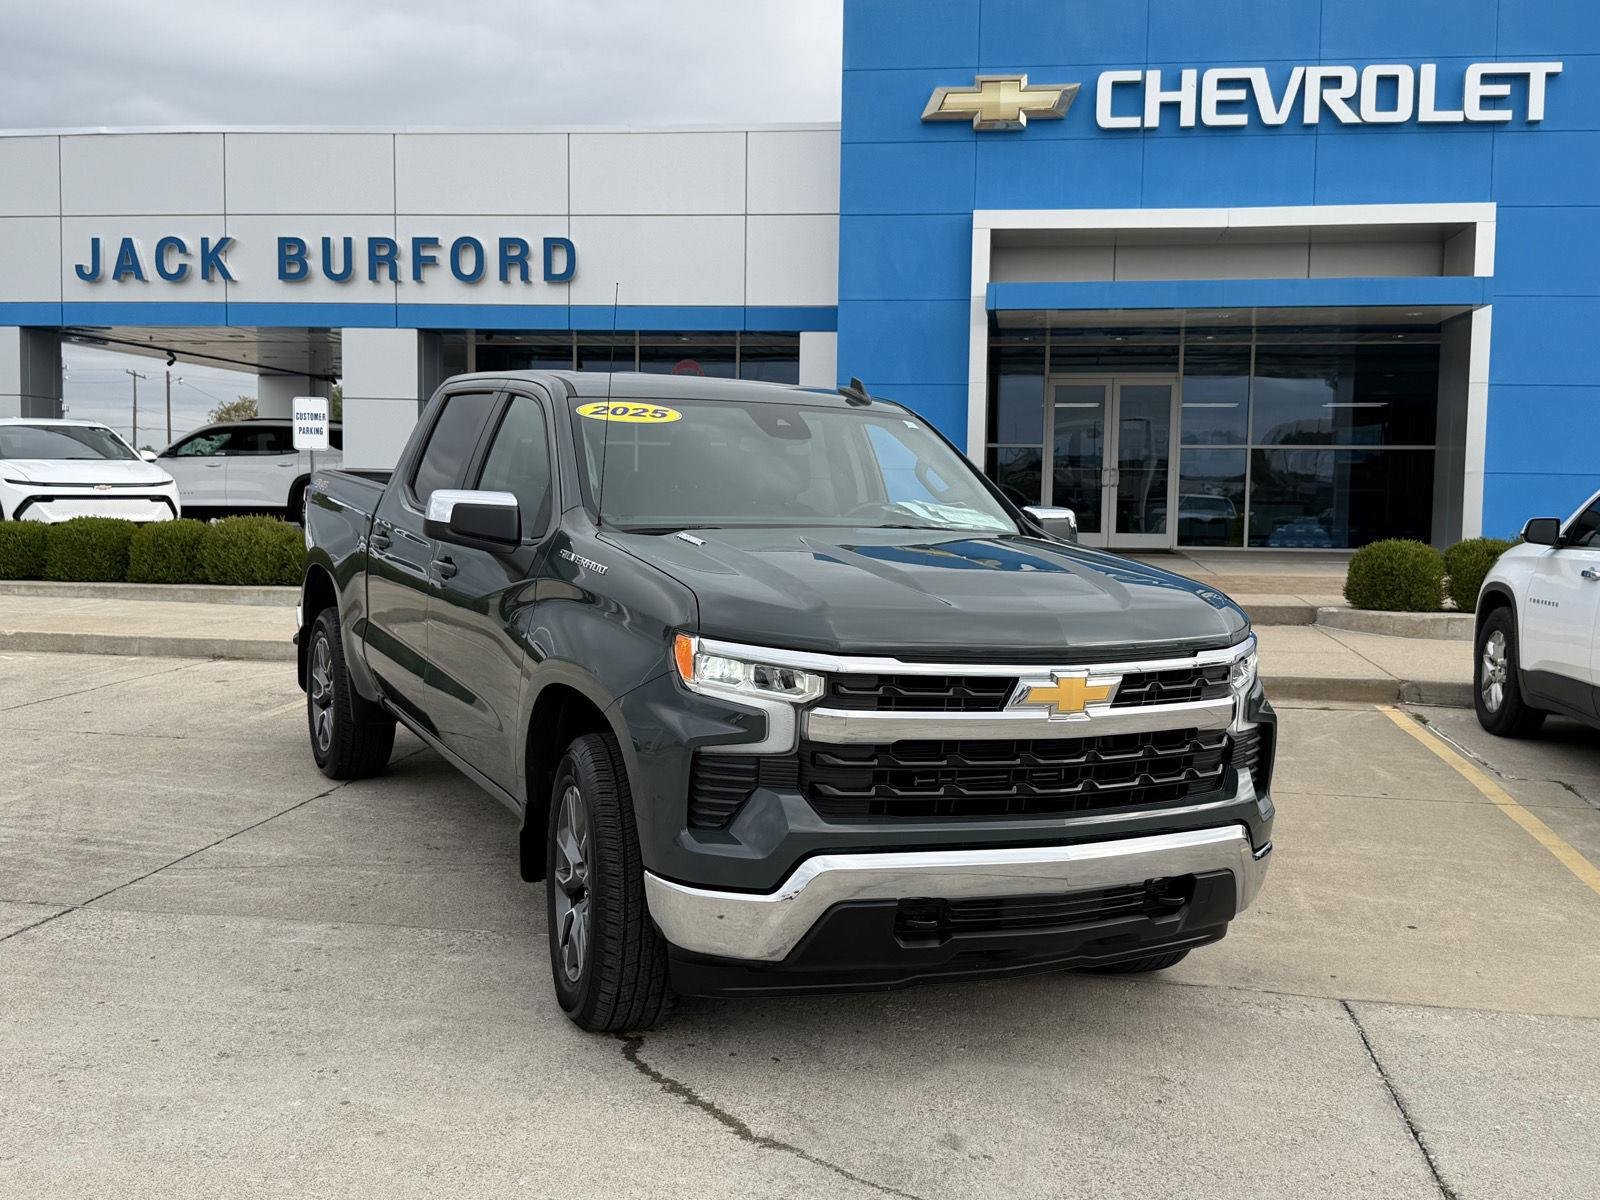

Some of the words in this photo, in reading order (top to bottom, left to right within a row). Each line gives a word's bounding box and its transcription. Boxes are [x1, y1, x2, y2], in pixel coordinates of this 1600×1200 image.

[1096, 61, 1563, 130] CHEVROLET
[75, 236, 240, 283] JACK
[277, 236, 578, 283] BURFORD
[296, 412, 326, 421] CUSTOMER
[590, 405, 669, 418] 2025
[298, 426, 323, 435] PARKING
